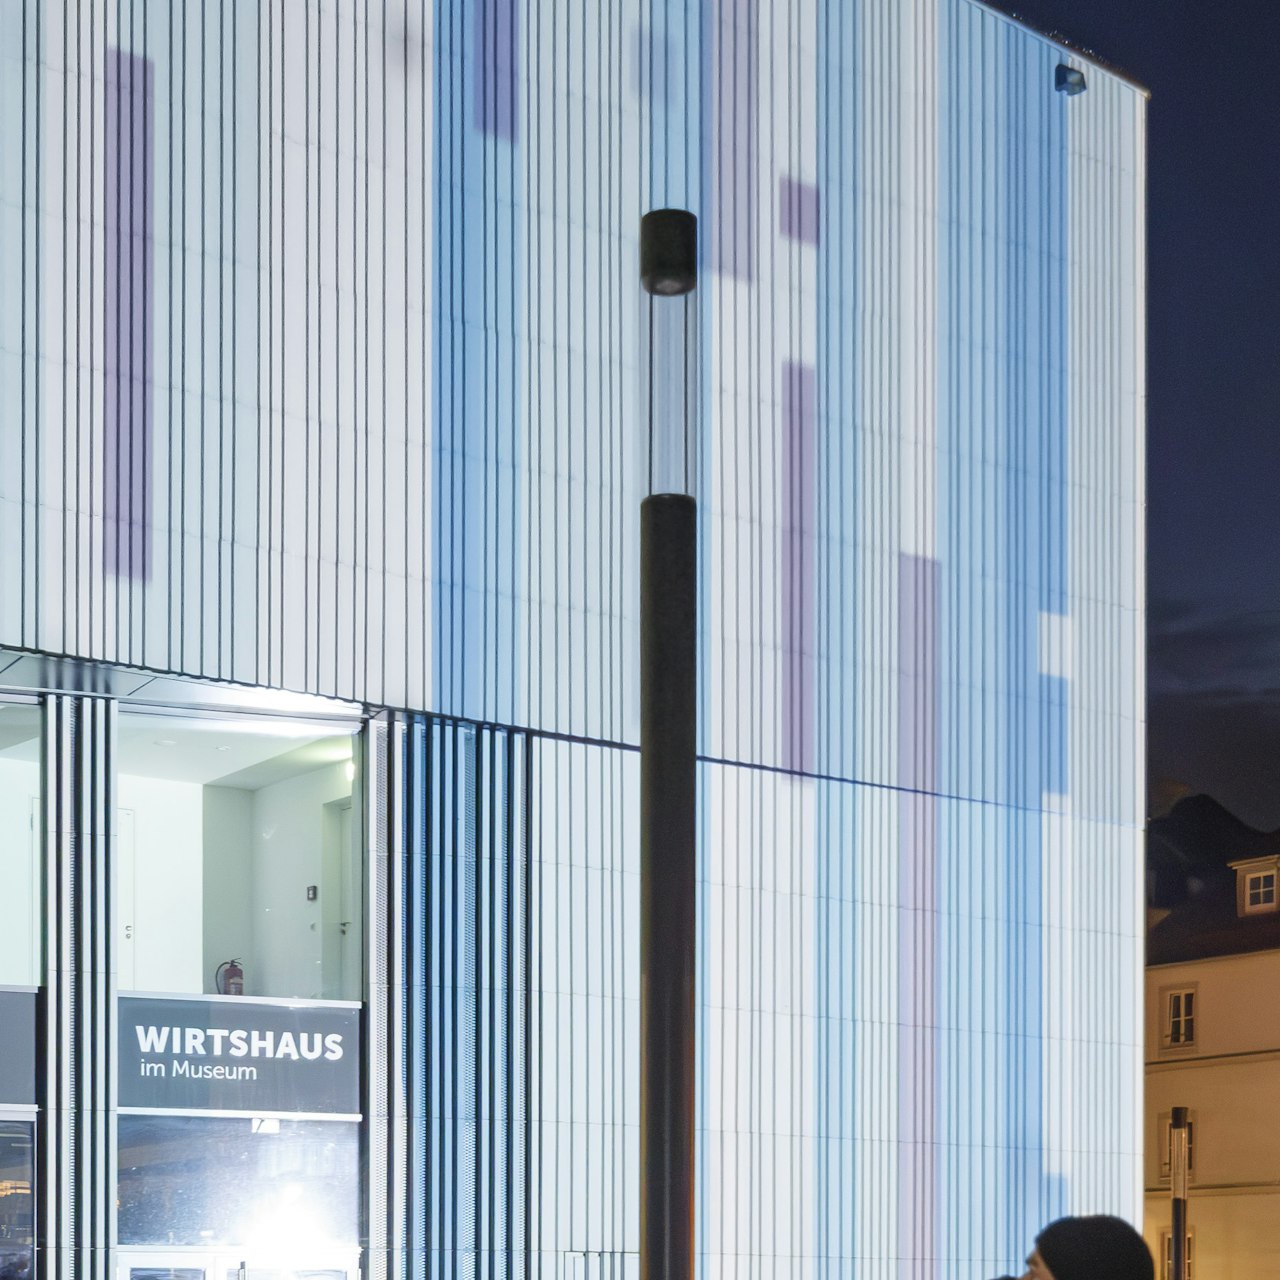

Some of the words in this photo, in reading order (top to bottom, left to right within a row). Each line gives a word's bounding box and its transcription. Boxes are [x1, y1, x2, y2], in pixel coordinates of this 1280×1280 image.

[135, 1025, 344, 1061] WIRTSHAUS
[140, 1059, 165, 1077] im
[172, 1060, 257, 1080] Museum
